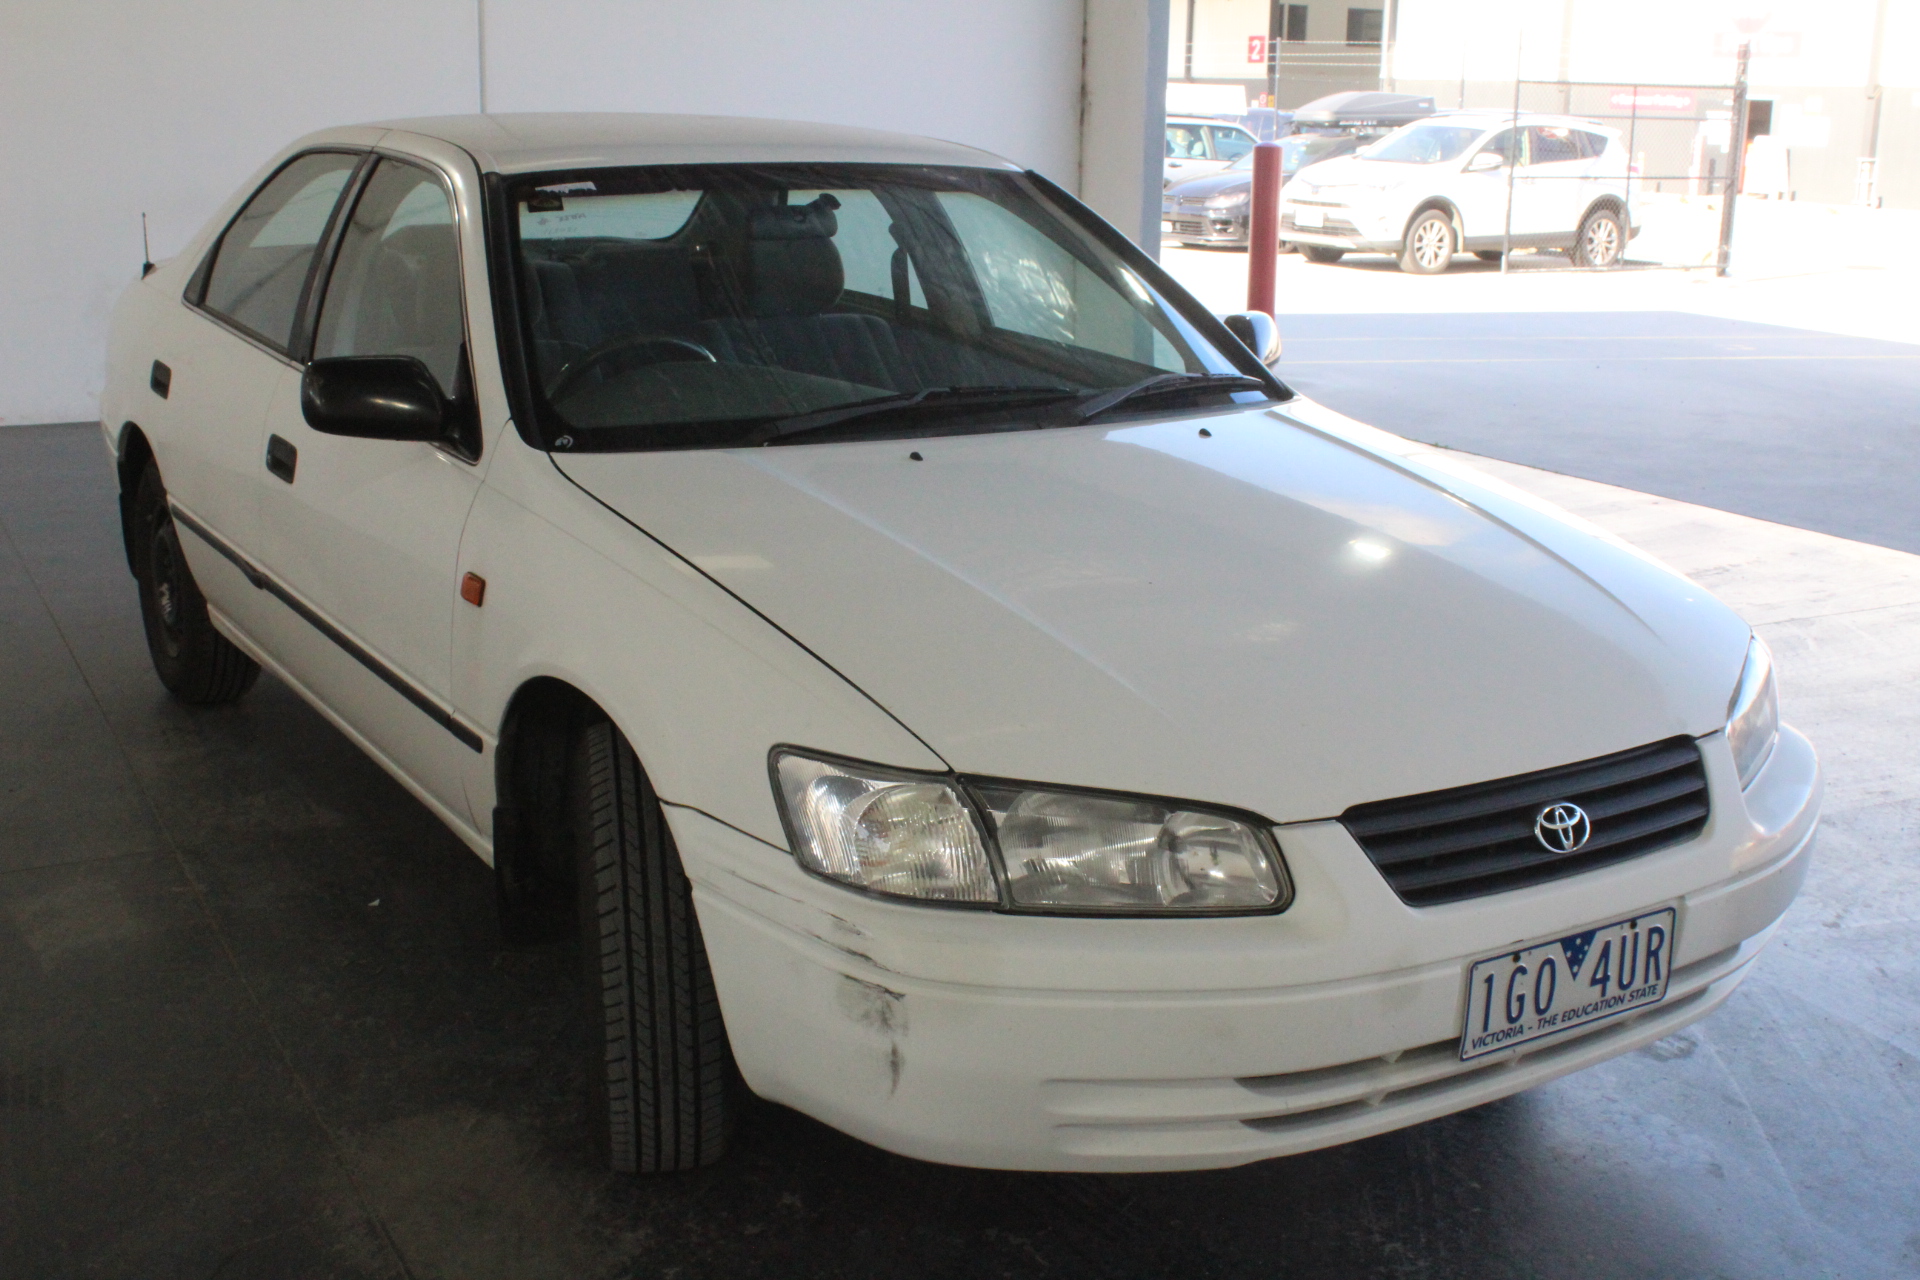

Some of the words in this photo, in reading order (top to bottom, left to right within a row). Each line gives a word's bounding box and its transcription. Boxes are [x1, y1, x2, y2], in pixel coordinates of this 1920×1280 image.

[1251, 39, 1261, 60] 2
[1589, 925, 1665, 998] 4UR
[1471, 1024, 1524, 1050] VICTORIA
[1537, 1013, 1559, 1030] THE
[1561, 994, 1626, 1022] EDUCATION
[1627, 984, 1659, 1003] STATE
